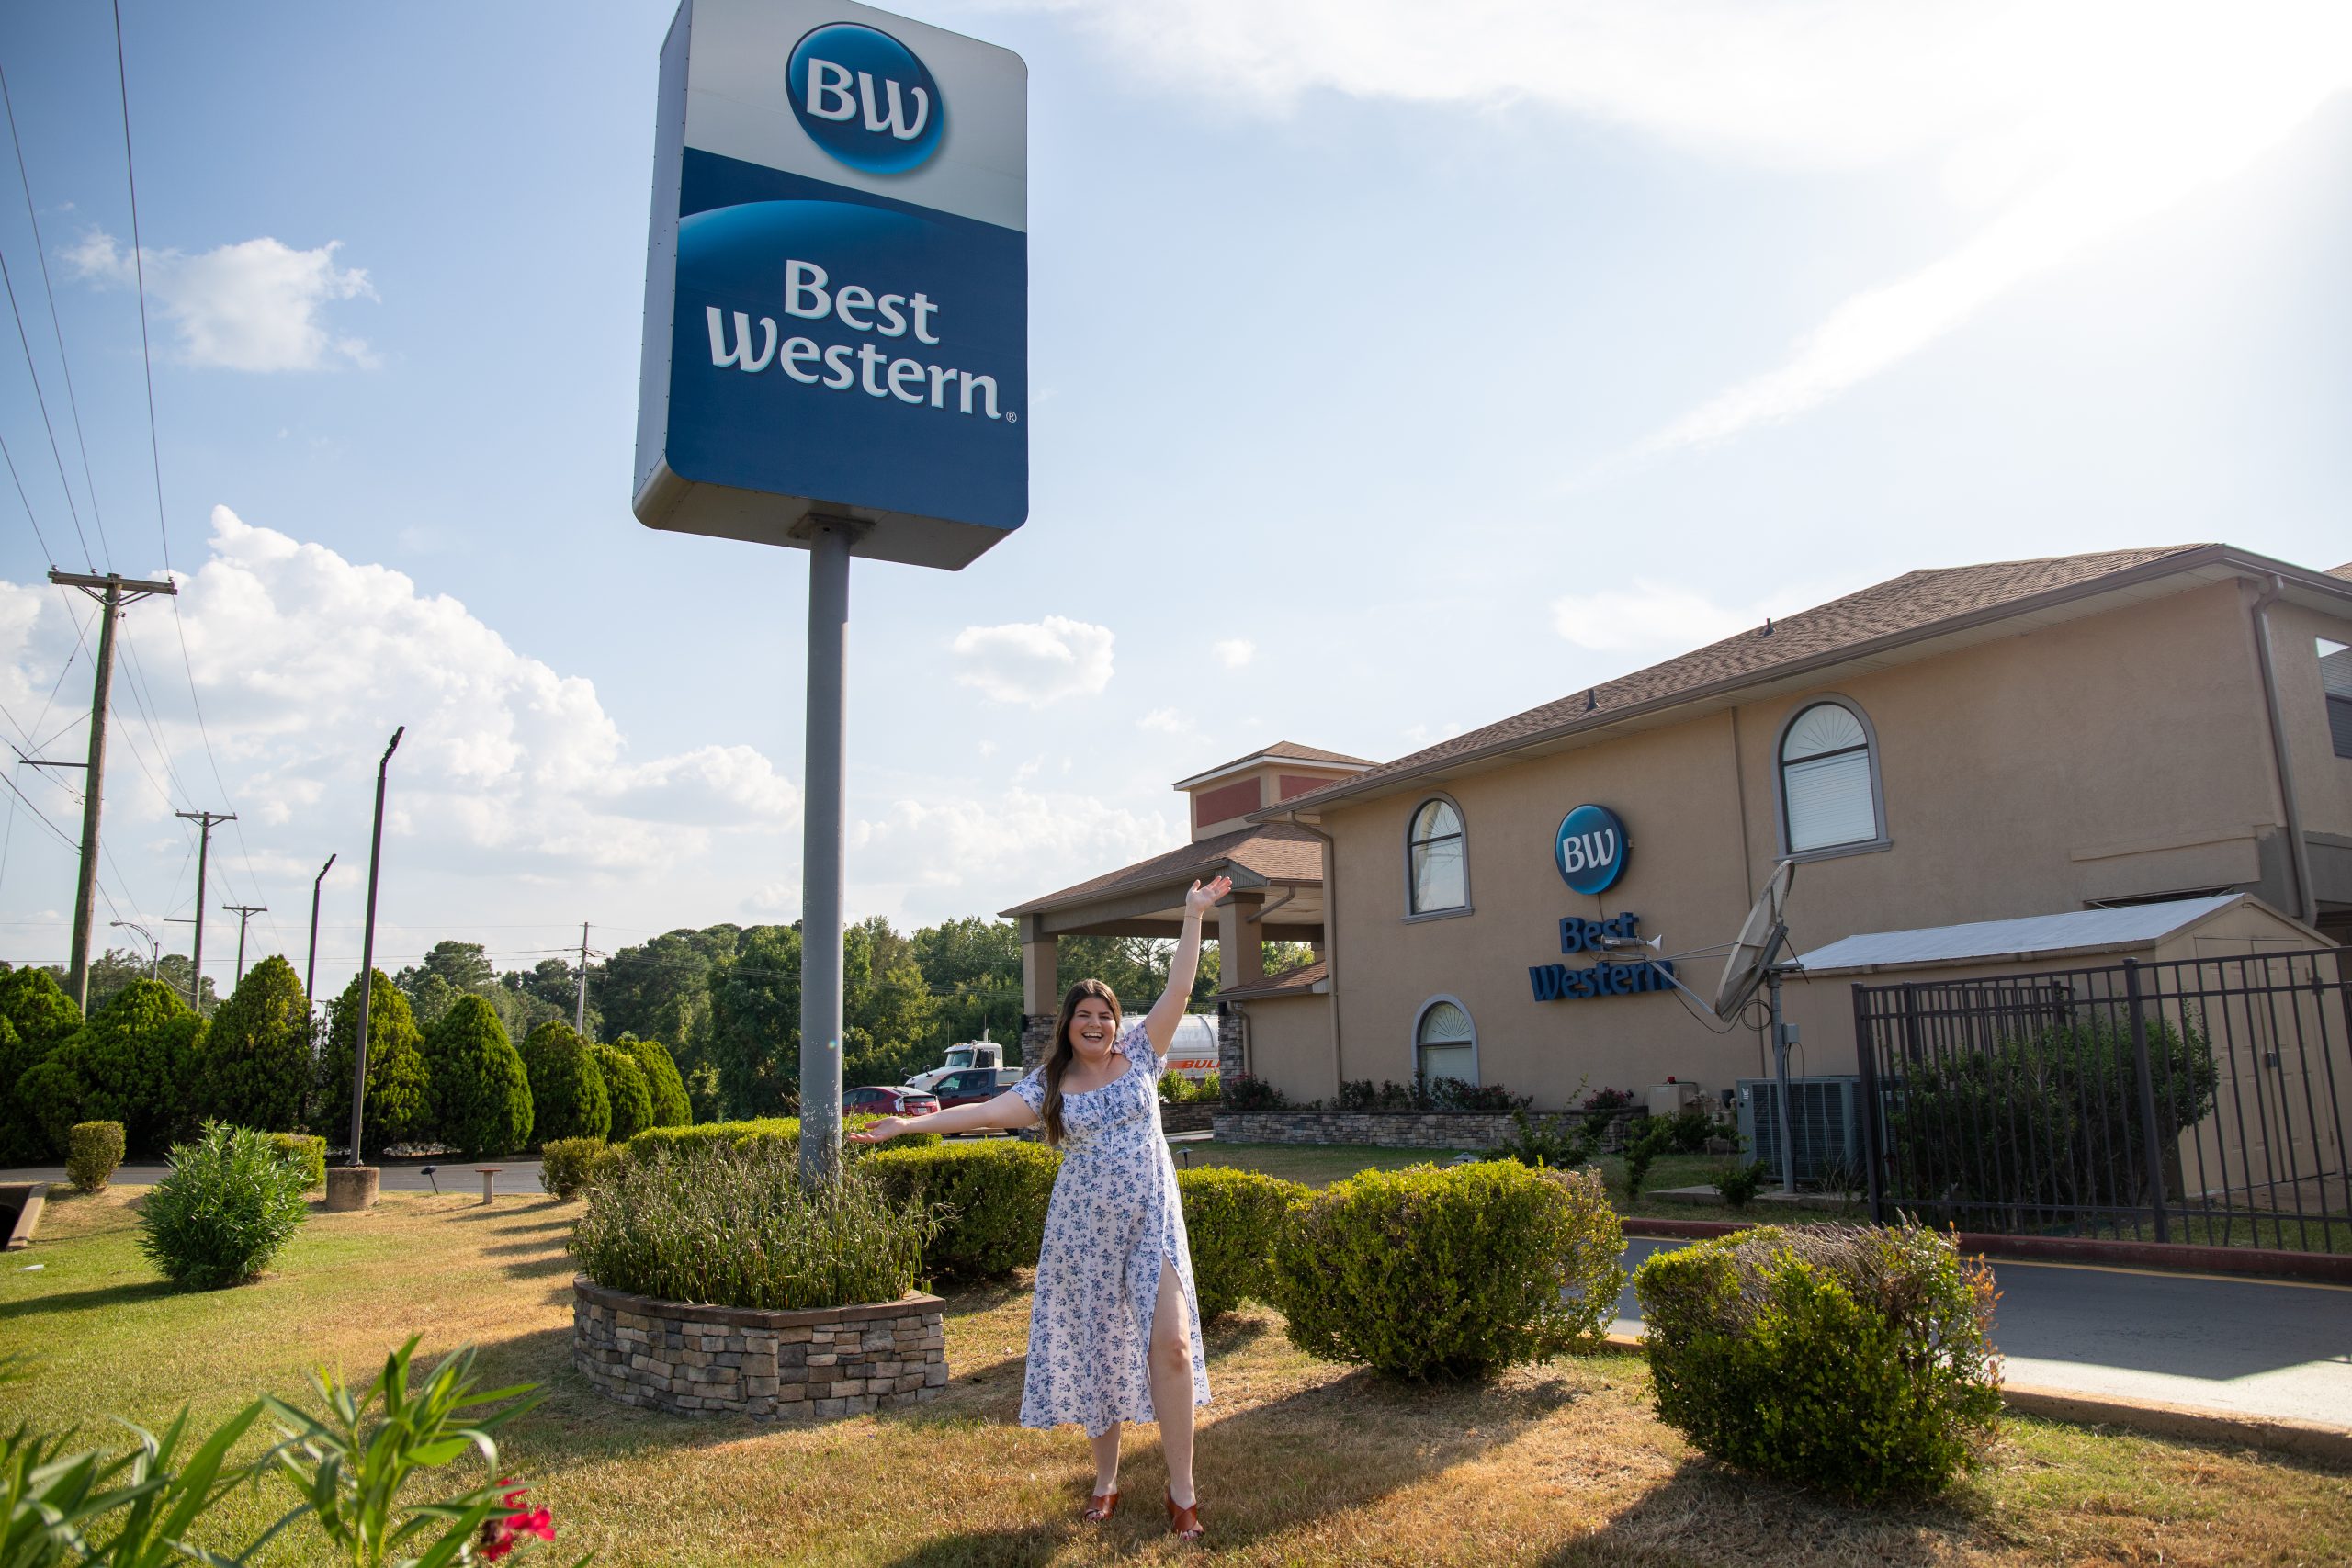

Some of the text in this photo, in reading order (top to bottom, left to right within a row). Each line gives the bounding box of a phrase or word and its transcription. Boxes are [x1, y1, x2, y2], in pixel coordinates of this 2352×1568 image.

[806, 58, 929, 141] BW
[785, 259, 940, 345] Best
[1562, 828, 1615, 874] BW
[1529, 960, 1678, 1002] Western
